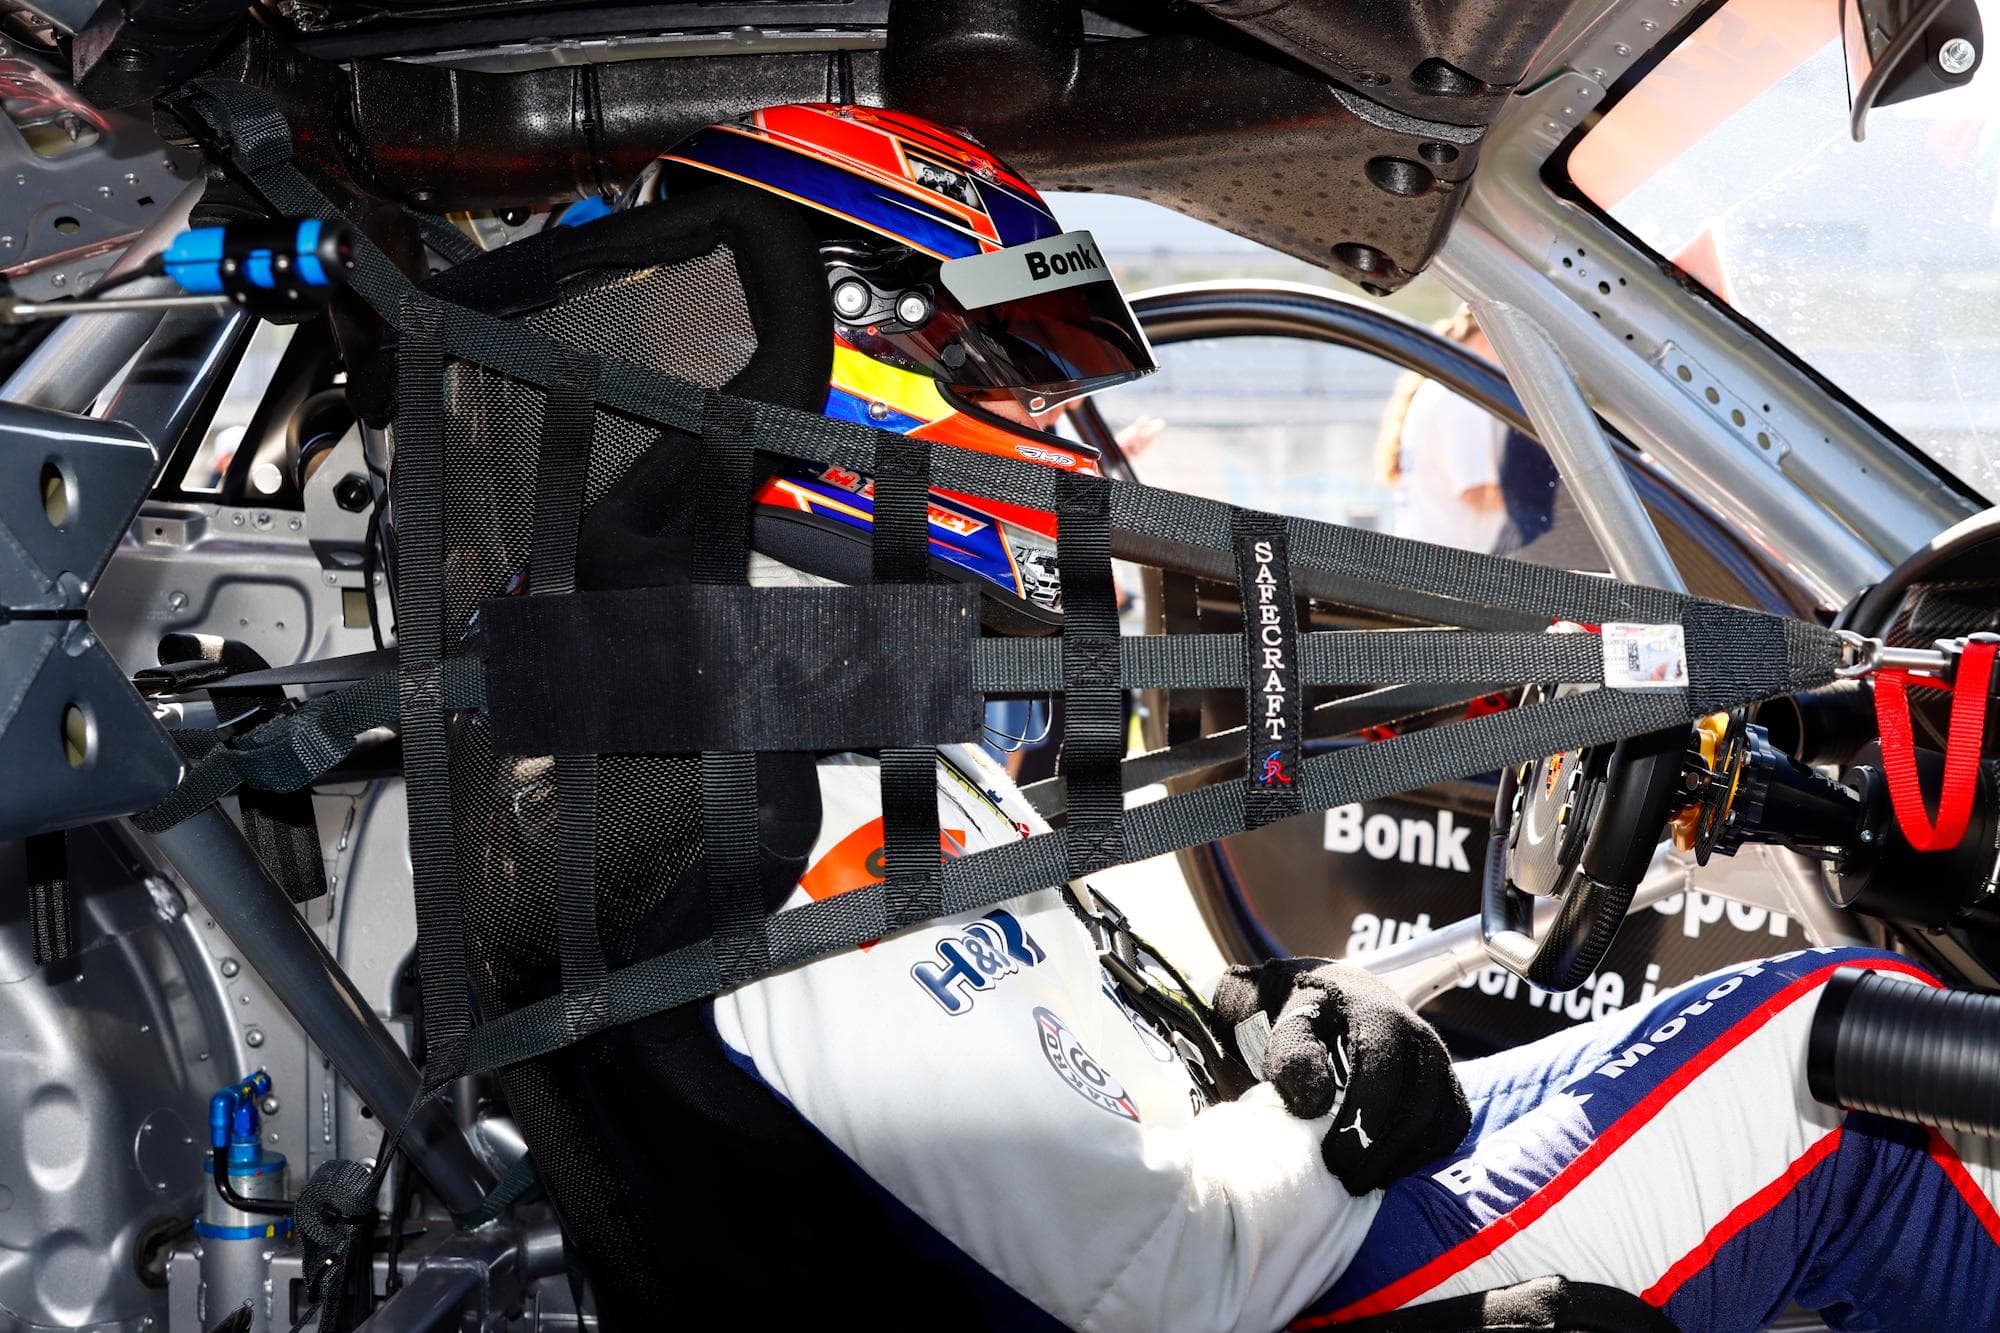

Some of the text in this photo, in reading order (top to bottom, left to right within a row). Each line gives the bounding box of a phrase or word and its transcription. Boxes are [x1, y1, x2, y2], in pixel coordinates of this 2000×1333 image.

[1024, 243, 1098, 281] Bonk
[1254, 542, 1286, 740] SAFECRAFT
[1323, 801, 1472, 873] Bonk
[911, 909, 1047, 1016] H&R
